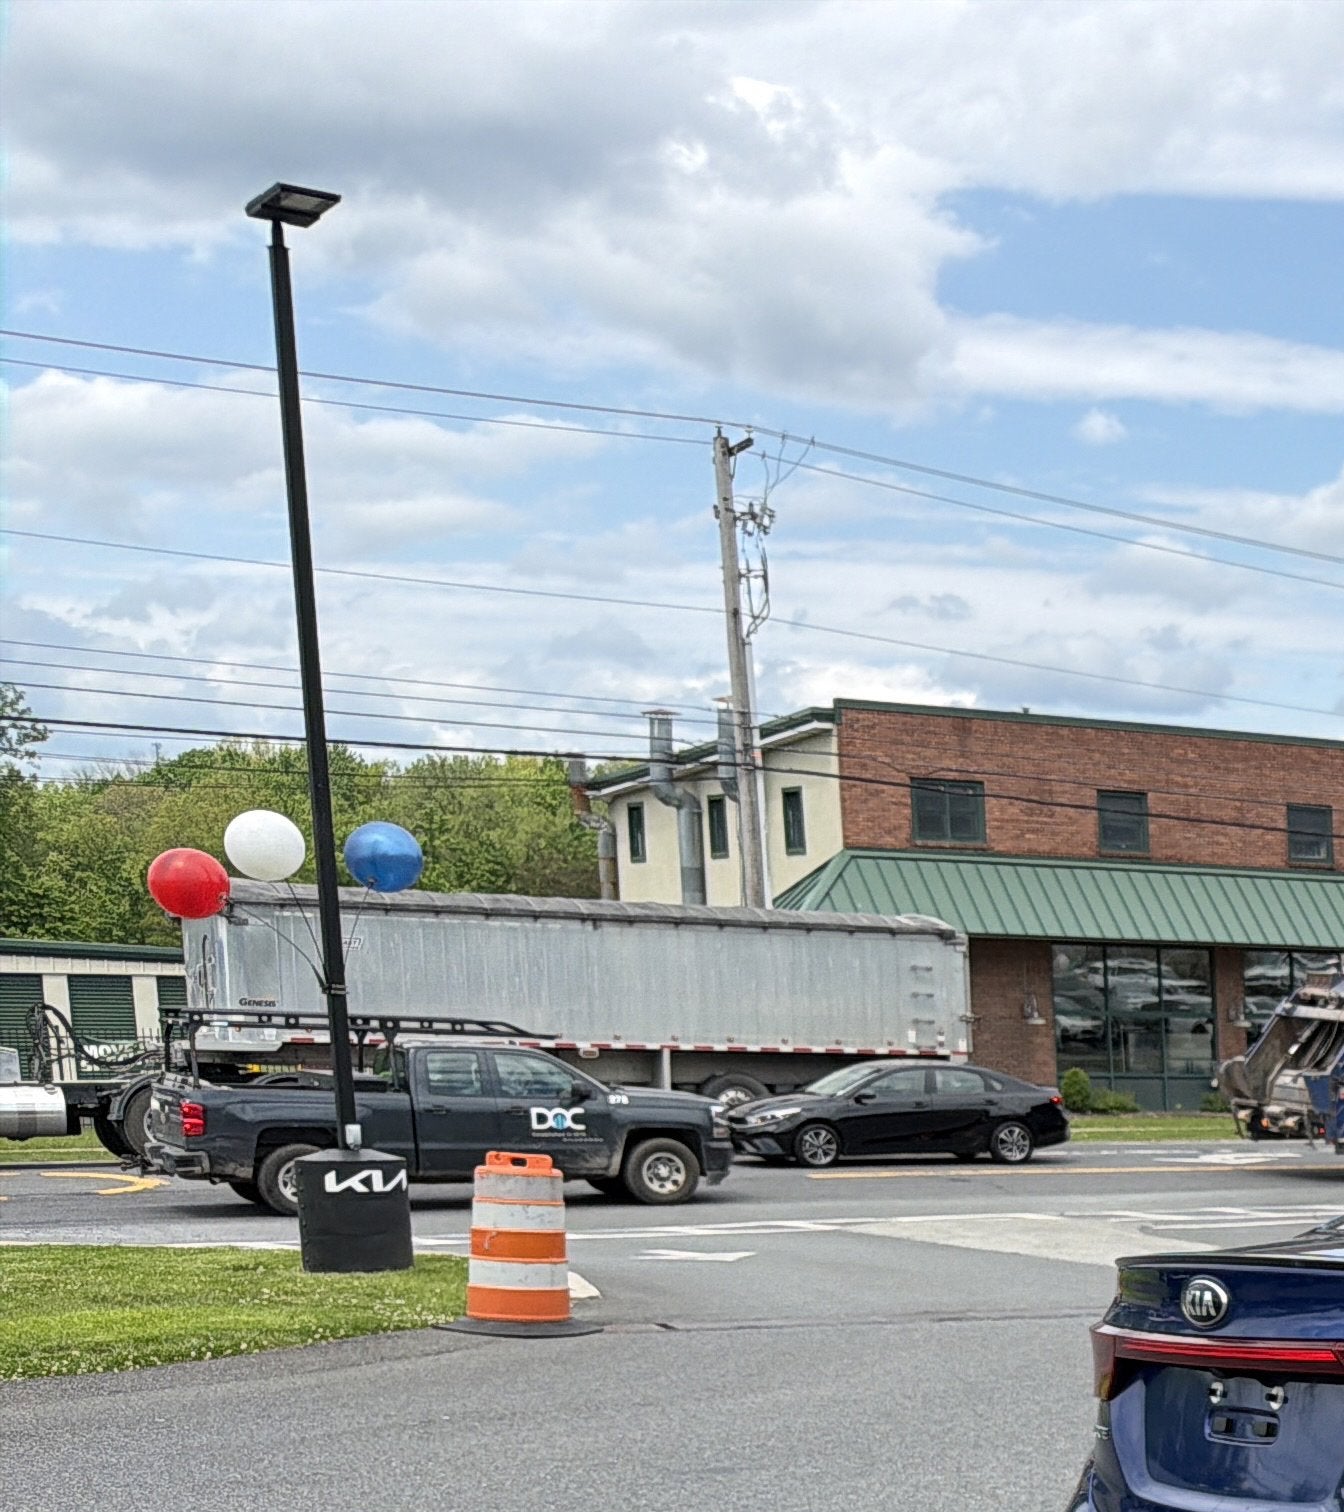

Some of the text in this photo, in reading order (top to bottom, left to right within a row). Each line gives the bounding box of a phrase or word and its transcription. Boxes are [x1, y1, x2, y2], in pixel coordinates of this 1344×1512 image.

[530, 1107, 586, 1130] DOC
[324, 1168, 408, 1193] KIA
[1186, 1290, 1217, 1317] KIA
